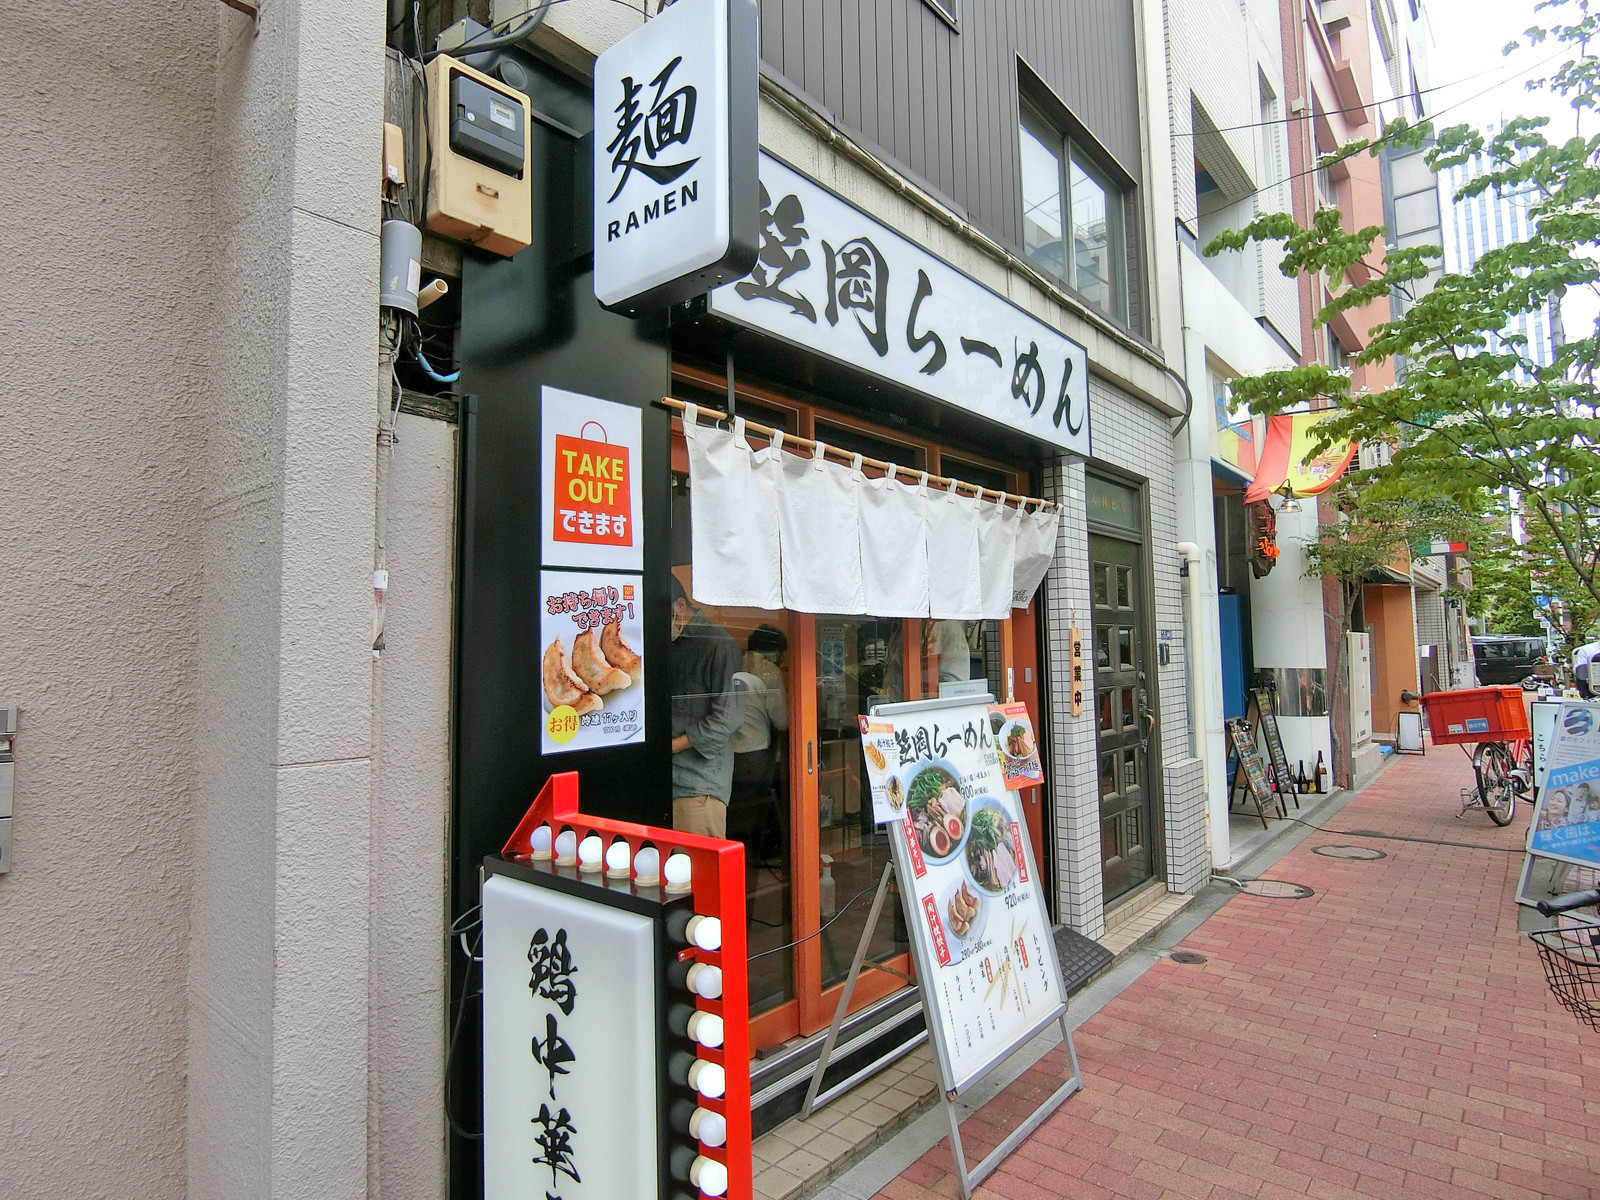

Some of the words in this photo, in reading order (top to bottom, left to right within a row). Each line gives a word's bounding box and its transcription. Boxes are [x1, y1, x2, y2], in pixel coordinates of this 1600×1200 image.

[607, 180, 699, 243] RAMEN
[562, 450, 624, 481] TAKE
[568, 479, 618, 505] OUT
[560, 509, 627, 537] できます
[547, 585, 619, 615] お持ち帰り
[1073, 641, 1082, 707] 営業中
[549, 715, 578, 732] お得
[895, 718, 992, 766] 笠岡らーめん
[1537, 733, 1547, 762] こちら
[1552, 765, 1600, 786] make
[1033, 934, 1048, 992] トッピング
[527, 927, 582, 1200] 鶏中華
